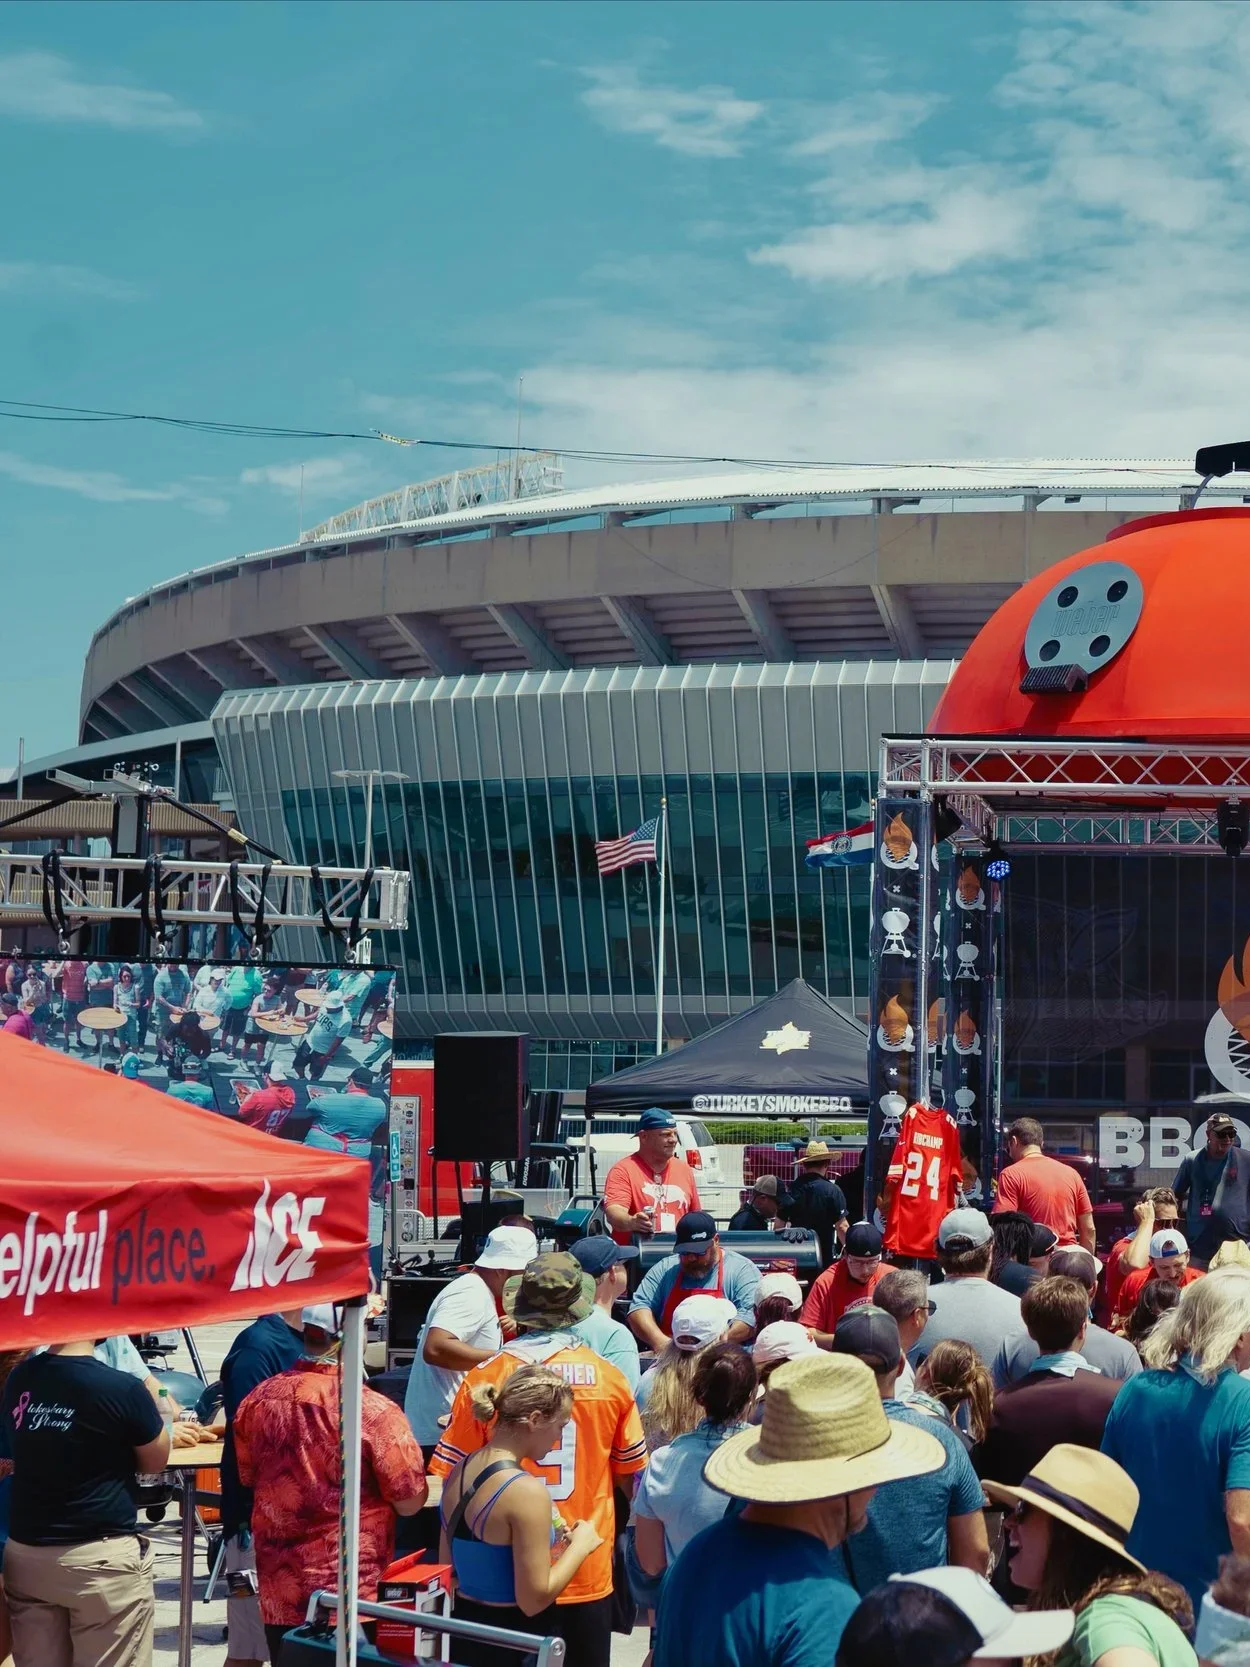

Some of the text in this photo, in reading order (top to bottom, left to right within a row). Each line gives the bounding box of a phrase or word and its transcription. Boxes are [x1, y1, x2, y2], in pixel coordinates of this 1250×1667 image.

[900, 1151, 942, 1201] 24
[112, 1208, 215, 1305] place.
[229, 1177, 327, 1292] ACE
